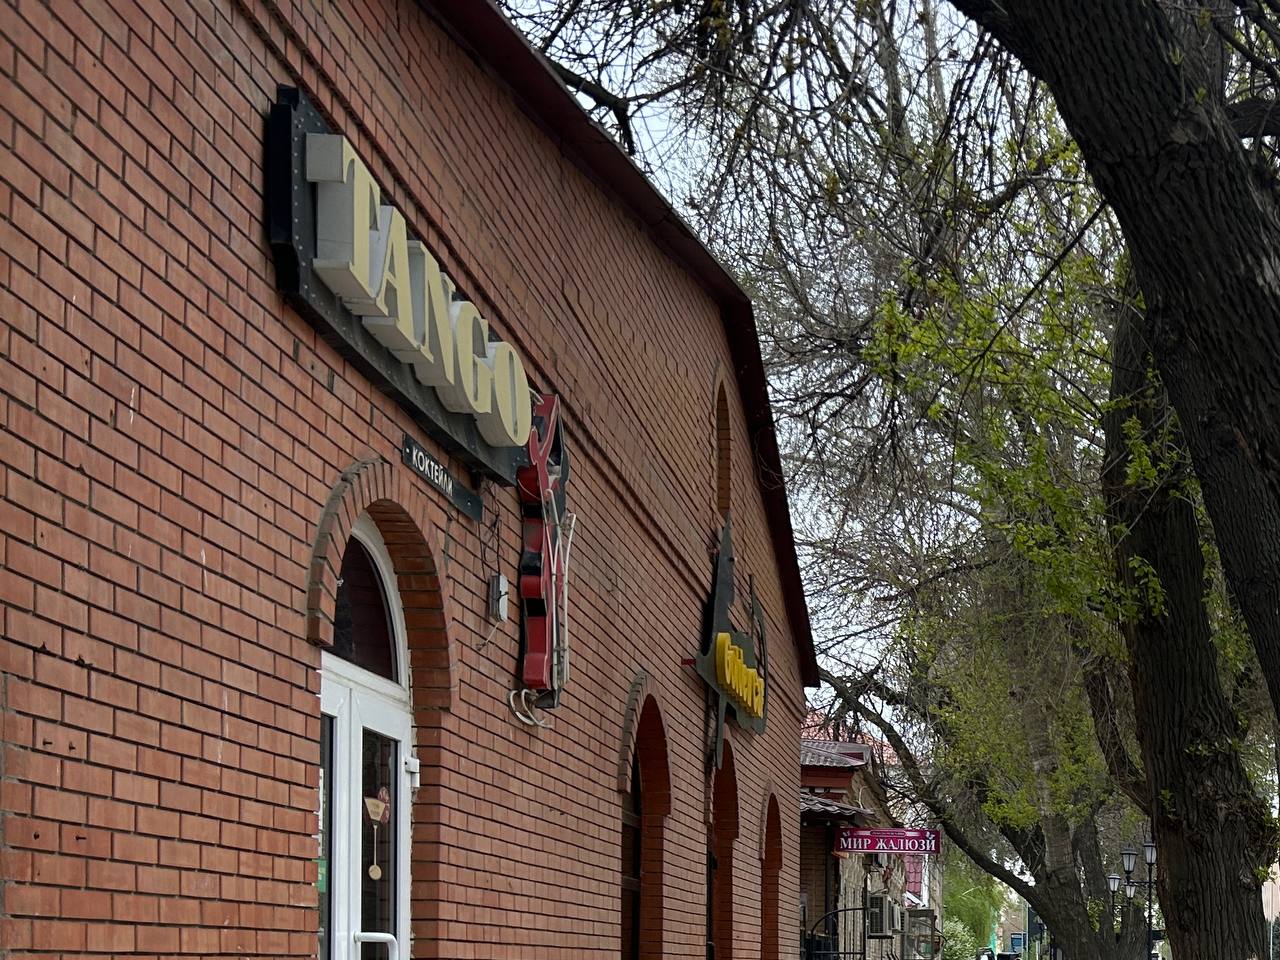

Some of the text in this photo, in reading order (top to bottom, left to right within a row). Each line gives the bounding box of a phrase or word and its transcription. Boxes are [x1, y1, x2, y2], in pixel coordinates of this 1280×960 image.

[306, 133, 532, 447] TANGO
[412, 446, 453, 497] КОКТЕЙЛИ
[840, 838, 936, 851] МИР ЖАЛЮЗИ
